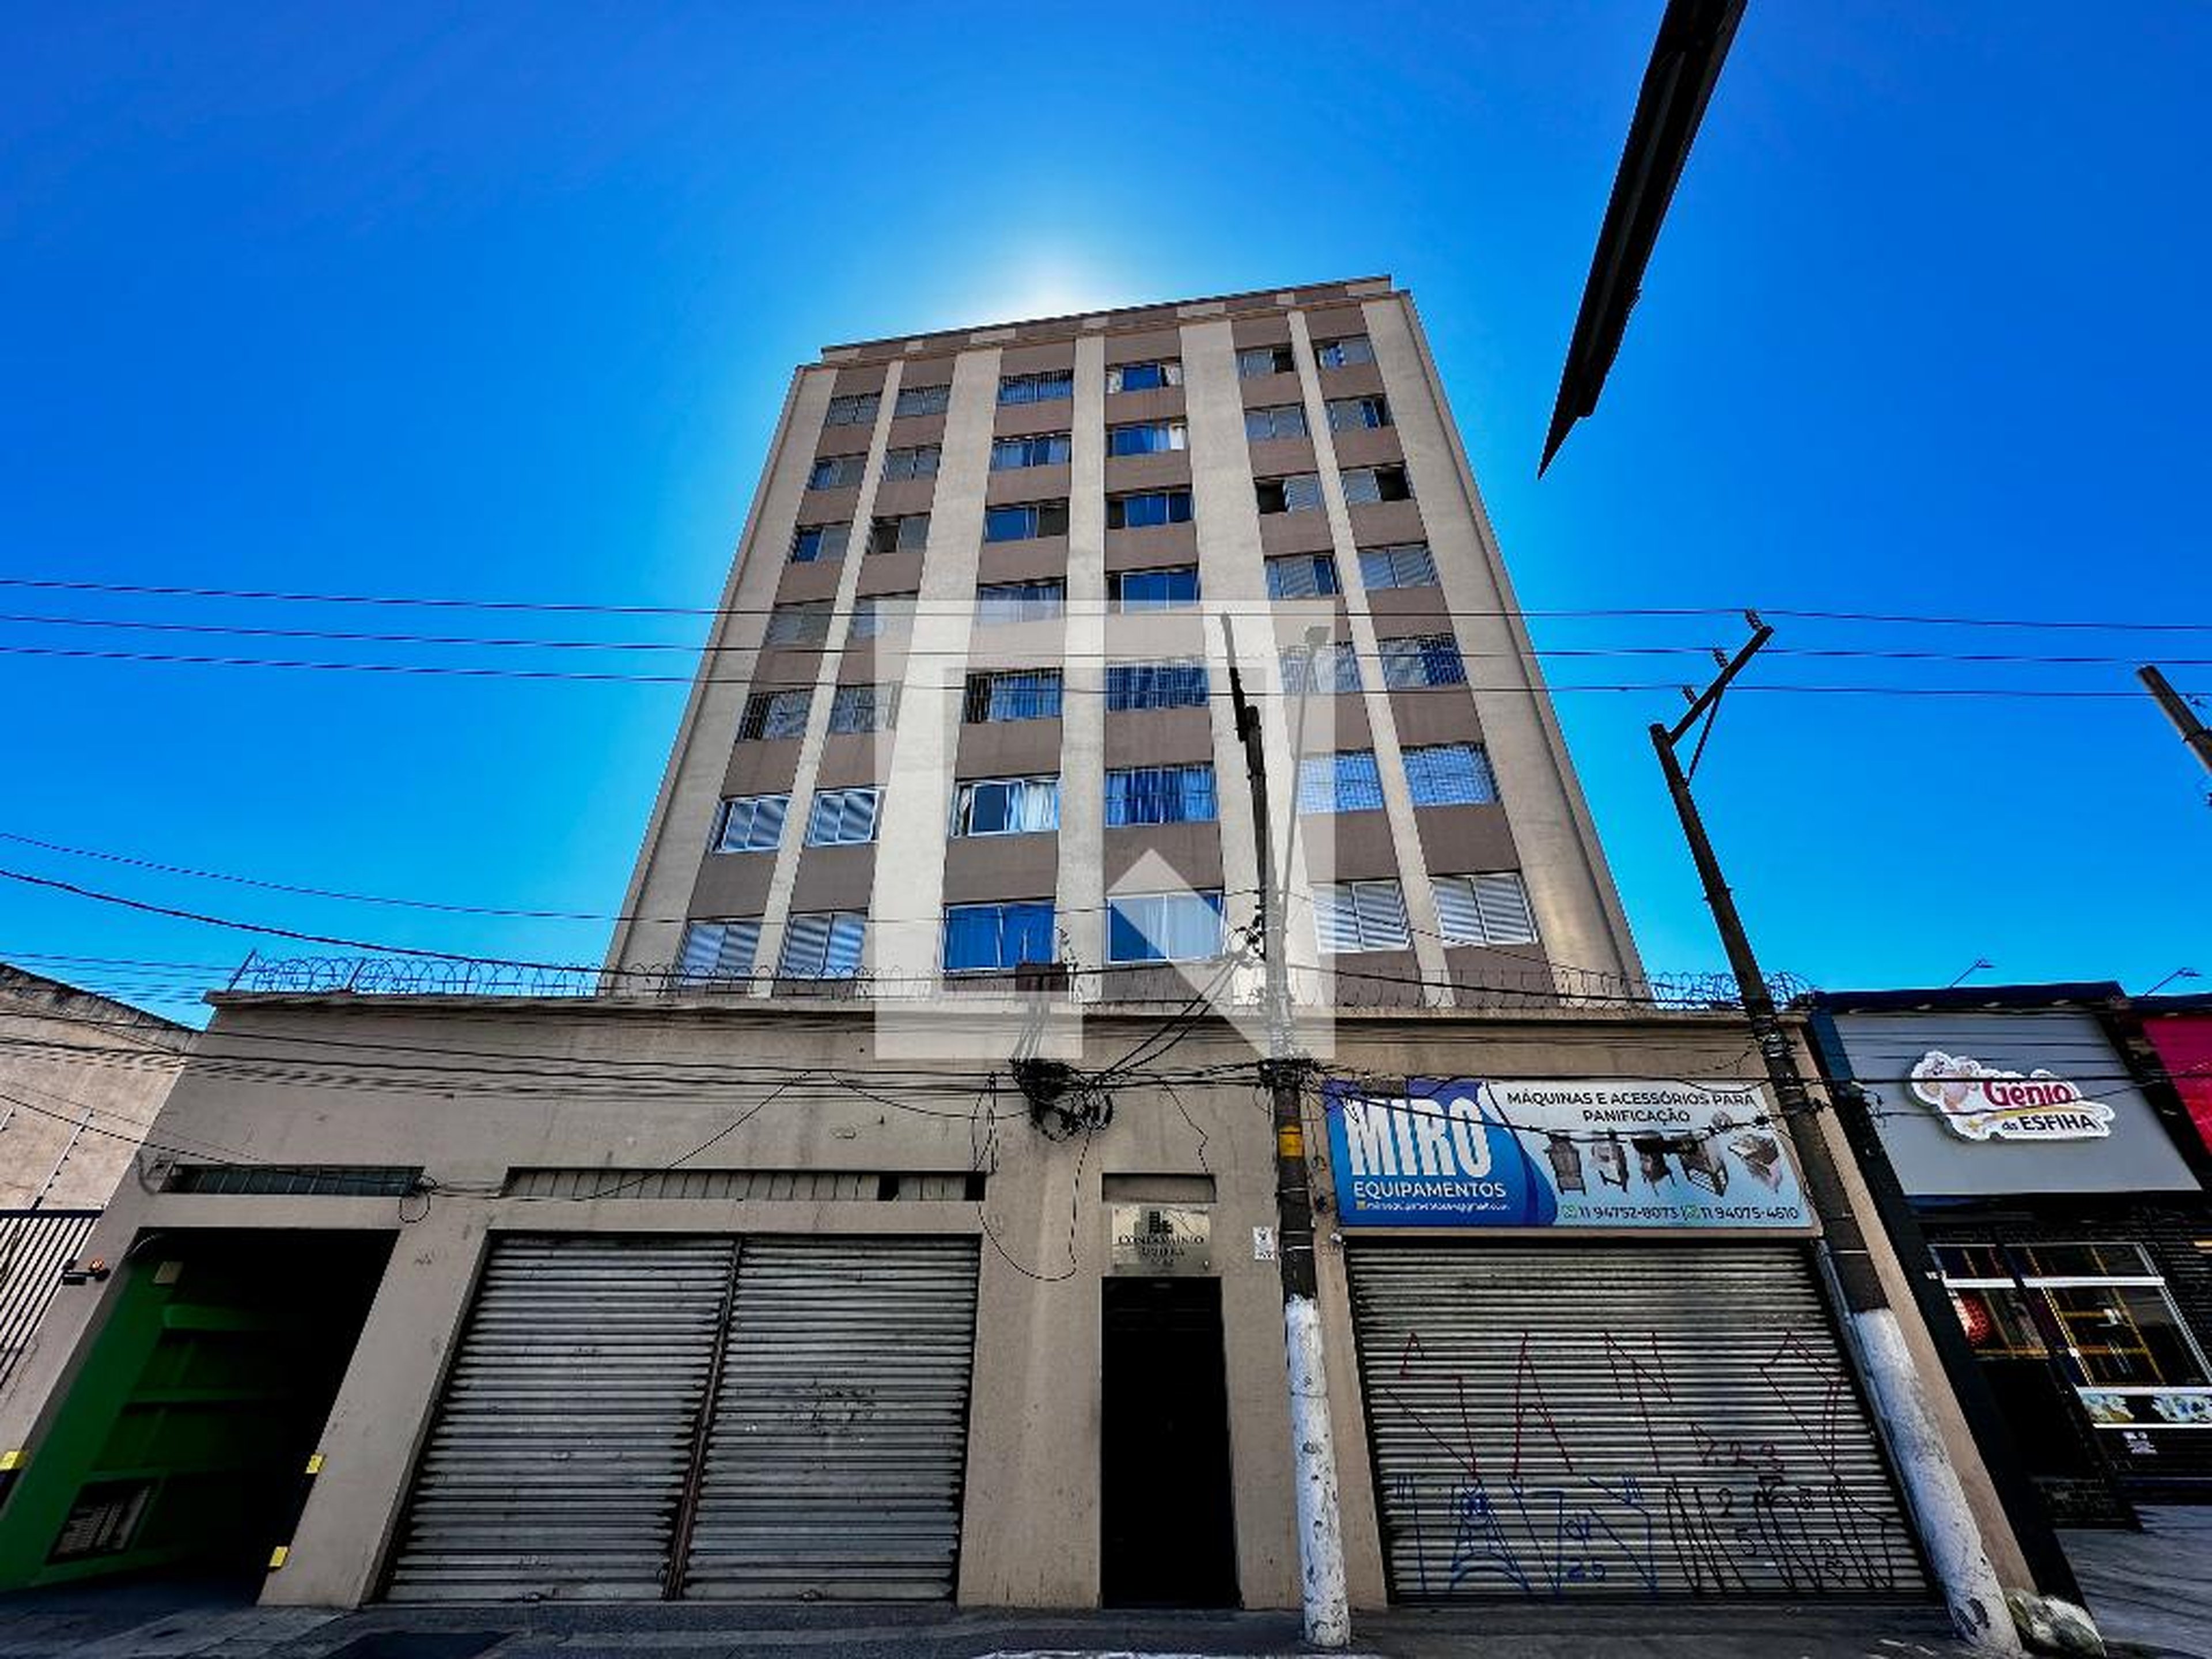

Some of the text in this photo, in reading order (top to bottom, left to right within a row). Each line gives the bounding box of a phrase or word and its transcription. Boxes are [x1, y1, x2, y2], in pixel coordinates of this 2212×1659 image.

[1507, 1089, 1756, 1107] MÁQUINAS E ACESSÓRIOS PARA
[1582, 1107, 1690, 1126] PANIFICAÇÃO
[2018, 1114, 2097, 1131] ESFIHA
[1343, 1097, 1492, 1178] MIRO
[1354, 1181, 1507, 1199] EQUIPAMENTOS
